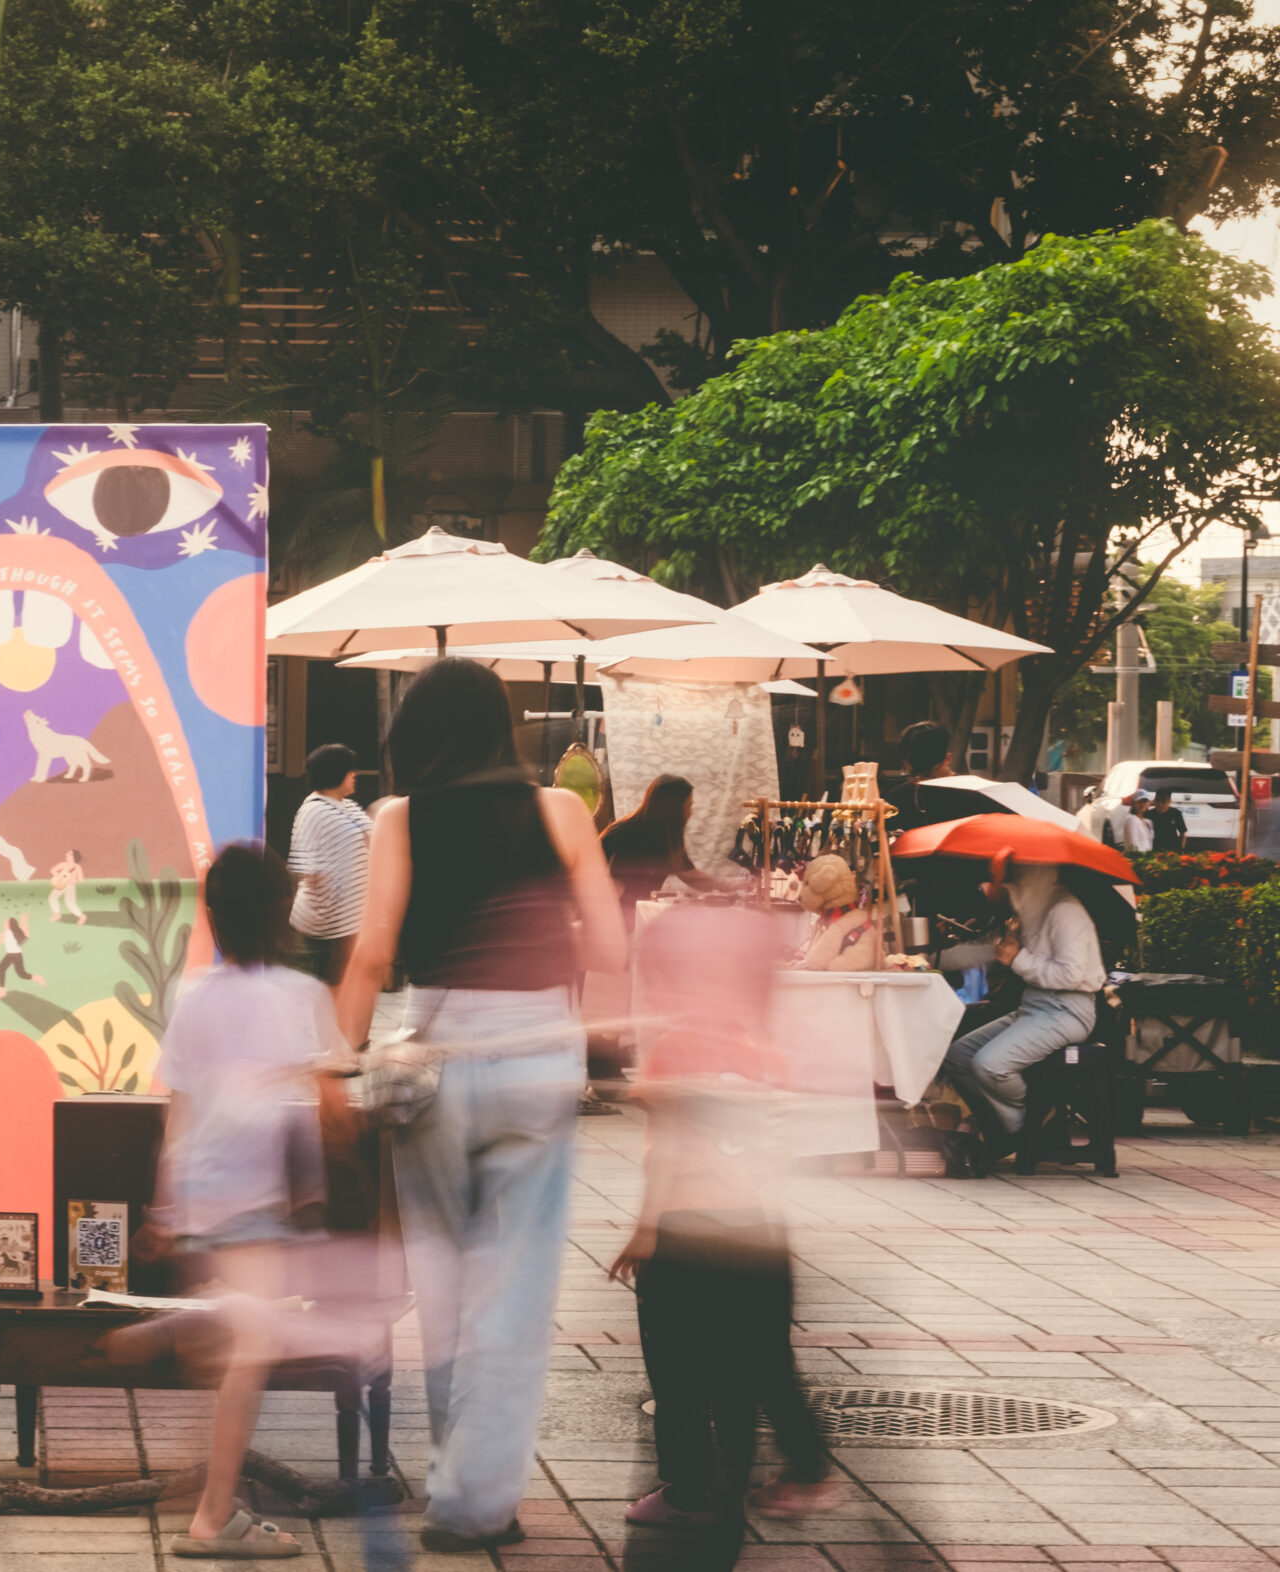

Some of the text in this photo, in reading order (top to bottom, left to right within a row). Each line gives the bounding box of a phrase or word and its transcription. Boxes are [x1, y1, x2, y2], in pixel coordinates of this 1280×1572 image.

[82, 599, 105, 619] IT
[102, 627, 143, 687] SEEMS
[138, 697, 158, 718] SO
[156, 733, 187, 786] REAL
[181, 797, 198, 823] TO
[193, 841, 213, 869] ME
